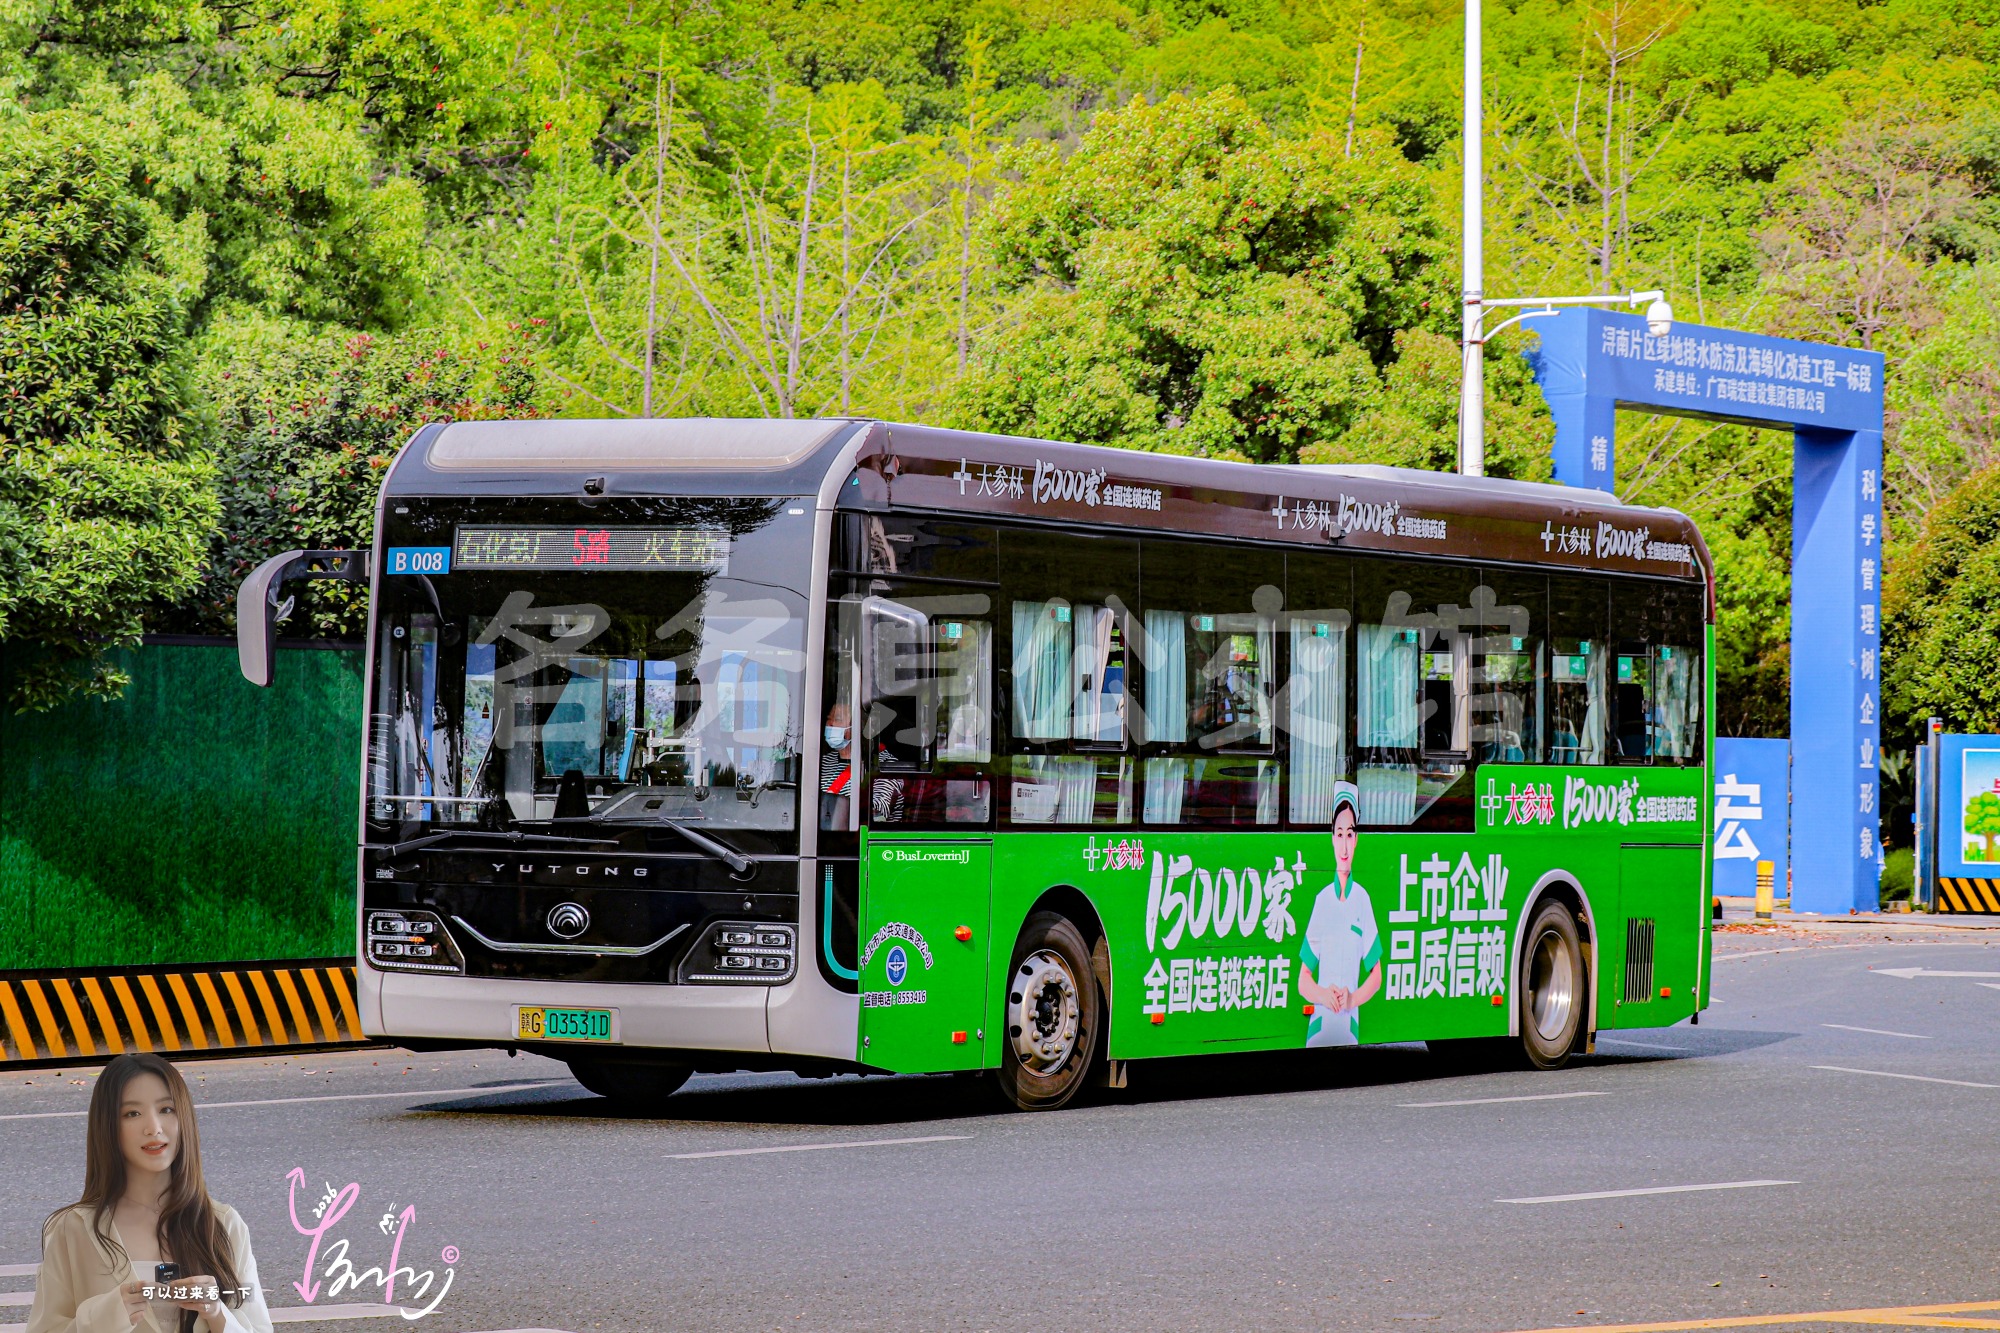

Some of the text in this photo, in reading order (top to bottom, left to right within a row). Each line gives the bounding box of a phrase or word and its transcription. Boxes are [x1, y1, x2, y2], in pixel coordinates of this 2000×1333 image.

[977, 464, 1024, 499] 大参林
[1103, 484, 1162, 511] 全国连锁药店
[1292, 500, 1330, 531] 大参林
[1396, 516, 1446, 540] 全国连锁药店
[394, 553, 443, 571] B 008
[458, 529, 719, 565] 石化总厂 5路 火车站
[1557, 525, 1591, 556] 大参林
[1646, 541, 1690, 563] 全国连锁药店
[1504, 783, 1555, 825] 大参林
[1636, 796, 1697, 823] 全国连锁药店
[1713, 773, 1762, 862] 宏
[492, 863, 648, 877] YUTONG
[1102, 839, 1144, 871] 大参林
[1388, 851, 1509, 924] 上市企业
[860, 922, 933, 970] 九江市公共交通集团公司
[1385, 925, 1506, 1000] 品质信赖
[1142, 954, 1290, 1014] 全国连锁药店
